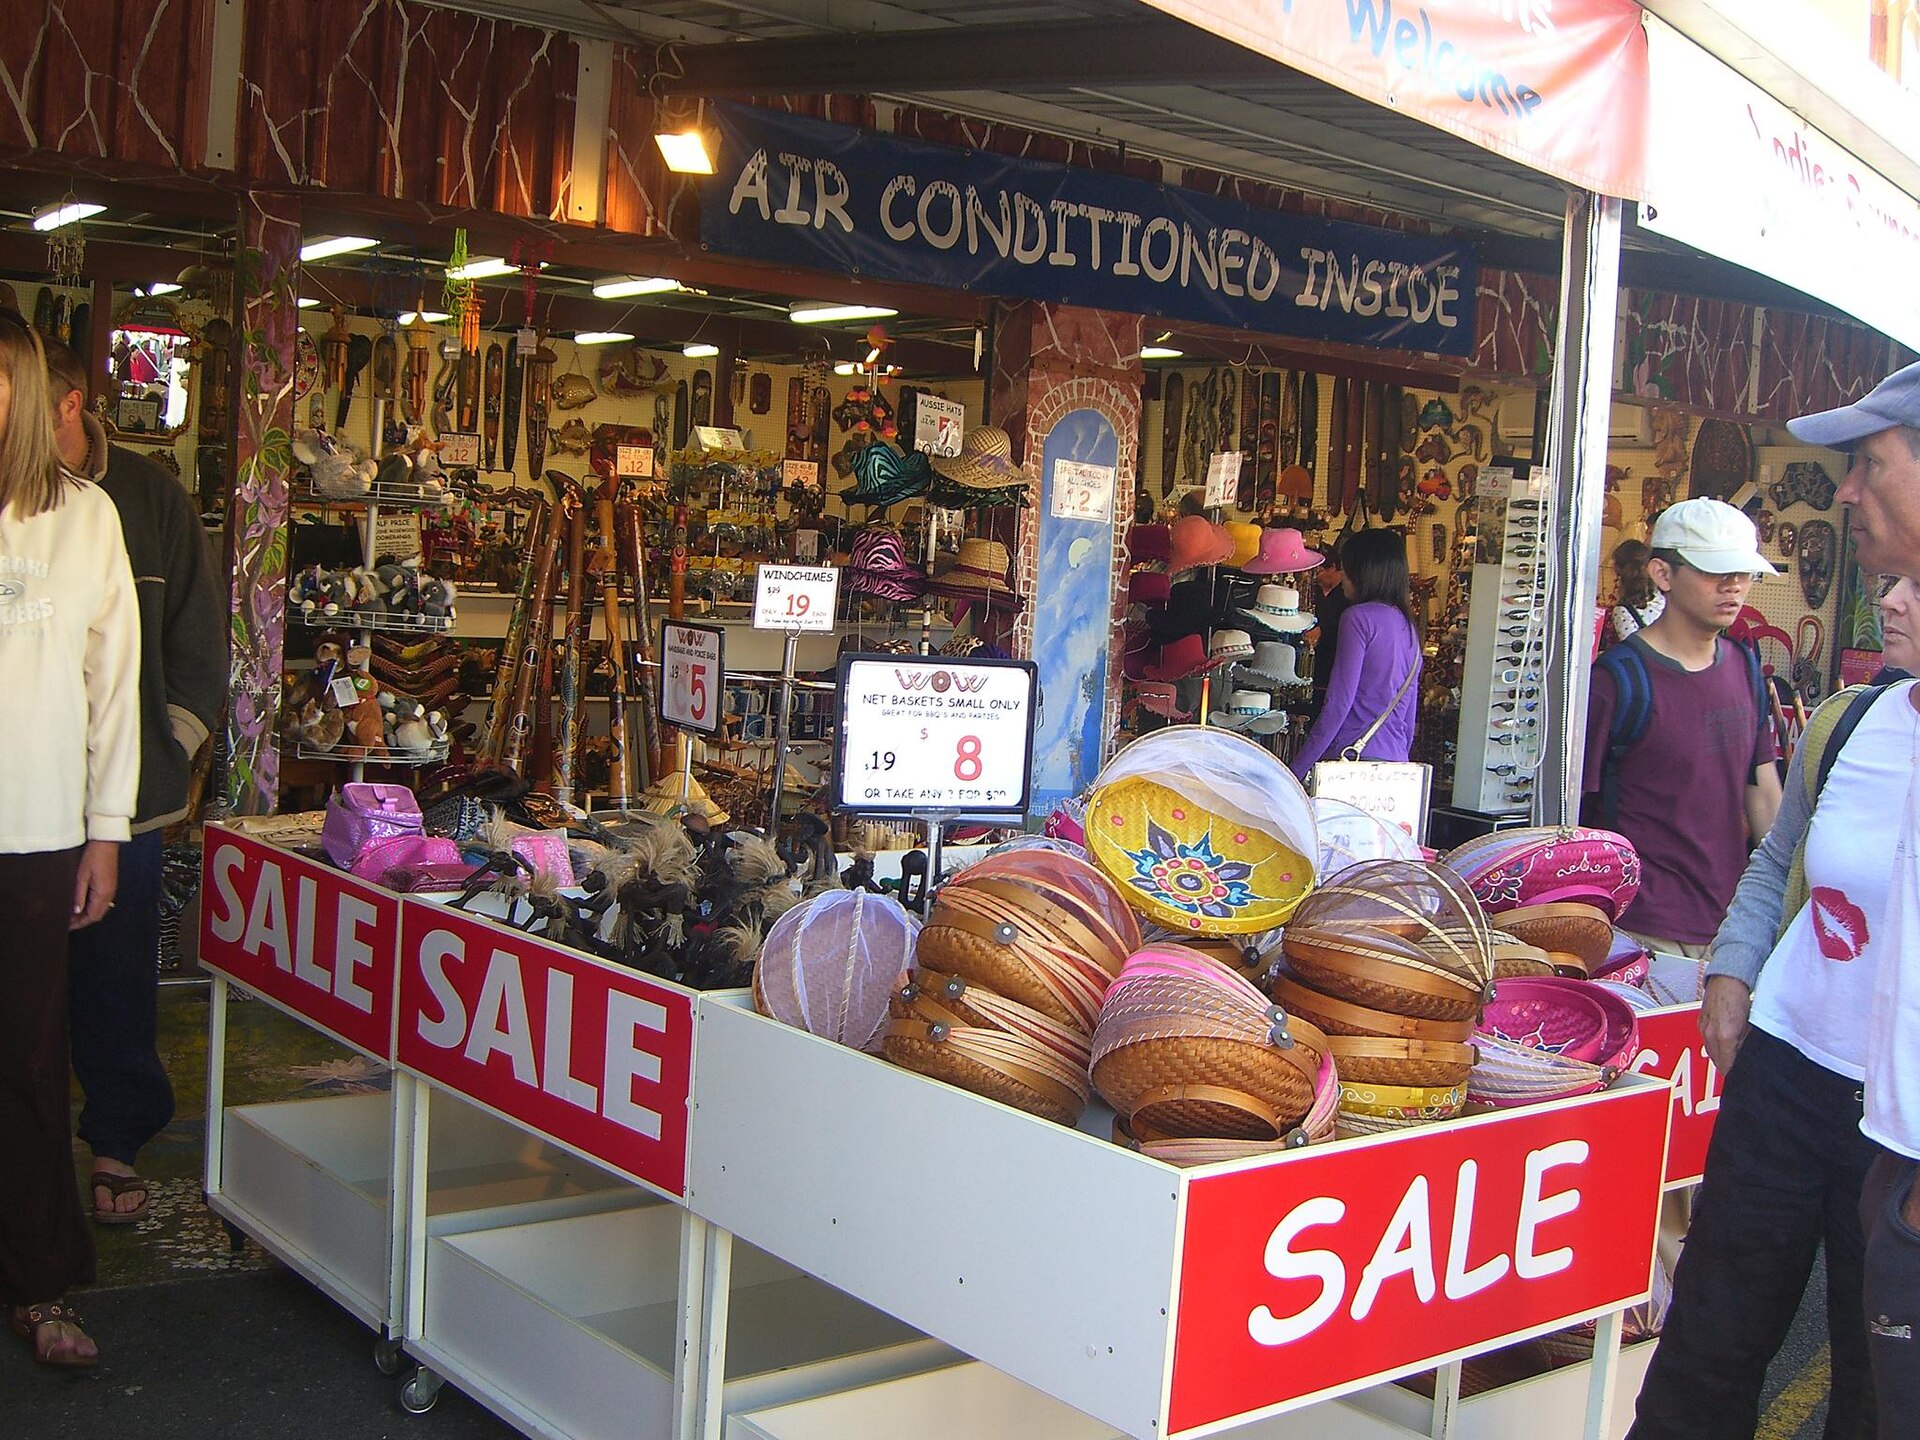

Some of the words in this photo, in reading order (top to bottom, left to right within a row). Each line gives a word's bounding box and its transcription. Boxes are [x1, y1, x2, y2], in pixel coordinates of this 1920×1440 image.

[1346, 0, 1542, 119] Welcome
[729, 147, 853, 233] AIR
[880, 175, 1281, 302] CONDITIONED
[1295, 247, 1460, 327] INSIDE
[920, 399, 945, 412] AUSSIE
[946, 404, 962, 416] HATS
[625, 460, 644, 474] $12
[763, 569, 834, 582] WINDCHIMES
[691, 664, 707, 721] 5
[894, 668, 989, 693] WOW
[863, 694, 887, 705] NET
[892, 695, 943, 707] BASKETS
[948, 698, 985, 709] SMALL
[990, 699, 1021, 711] ONLY
[907, 710, 922, 718] FOR
[954, 735, 983, 782] 8
[864, 788, 881, 799] OR
[886, 788, 915, 800] TAKE
[919, 789, 943, 800] ANY
[211, 843, 378, 1015] SALE
[417, 929, 668, 1142] SALE
[1247, 1139, 1590, 1347] SALE
